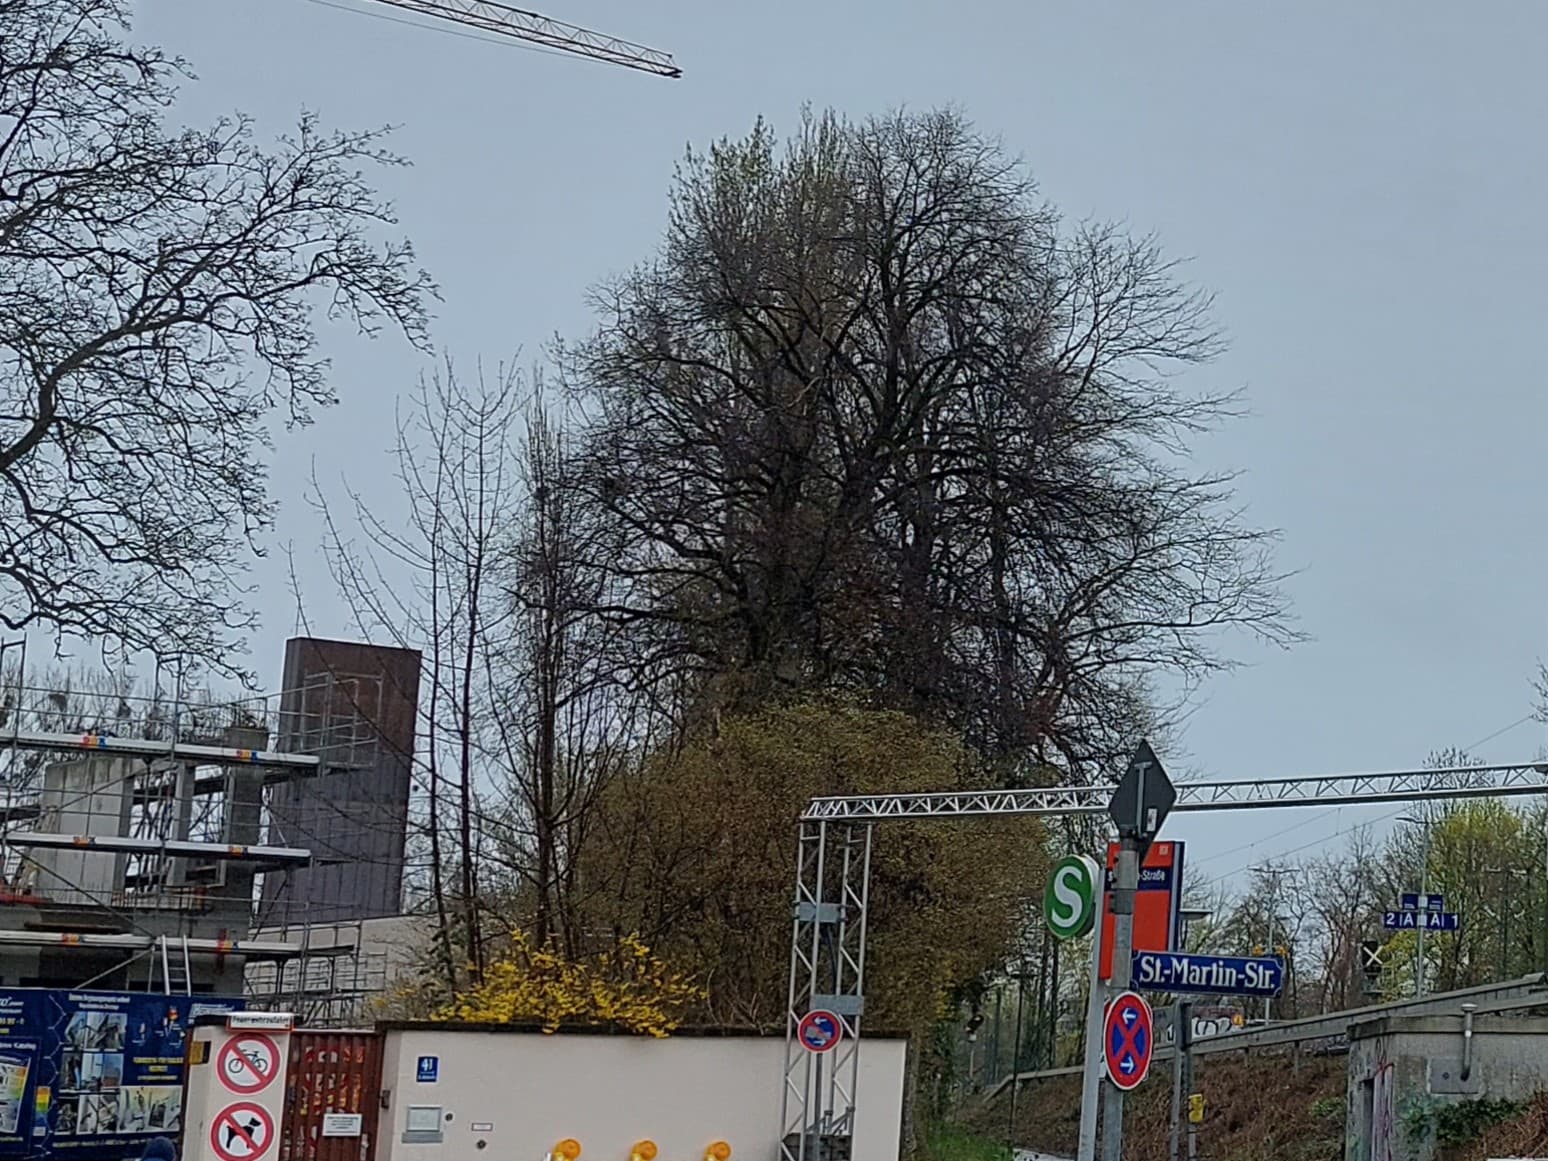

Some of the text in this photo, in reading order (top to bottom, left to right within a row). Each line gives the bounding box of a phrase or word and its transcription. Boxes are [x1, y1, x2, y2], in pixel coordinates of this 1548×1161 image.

[1051, 865, 1083, 928] S
[1386, 912, 1414, 927] 2 A
[1430, 913, 1459, 928] A 1
[1139, 955, 1276, 990] St.-Martin-Str.
